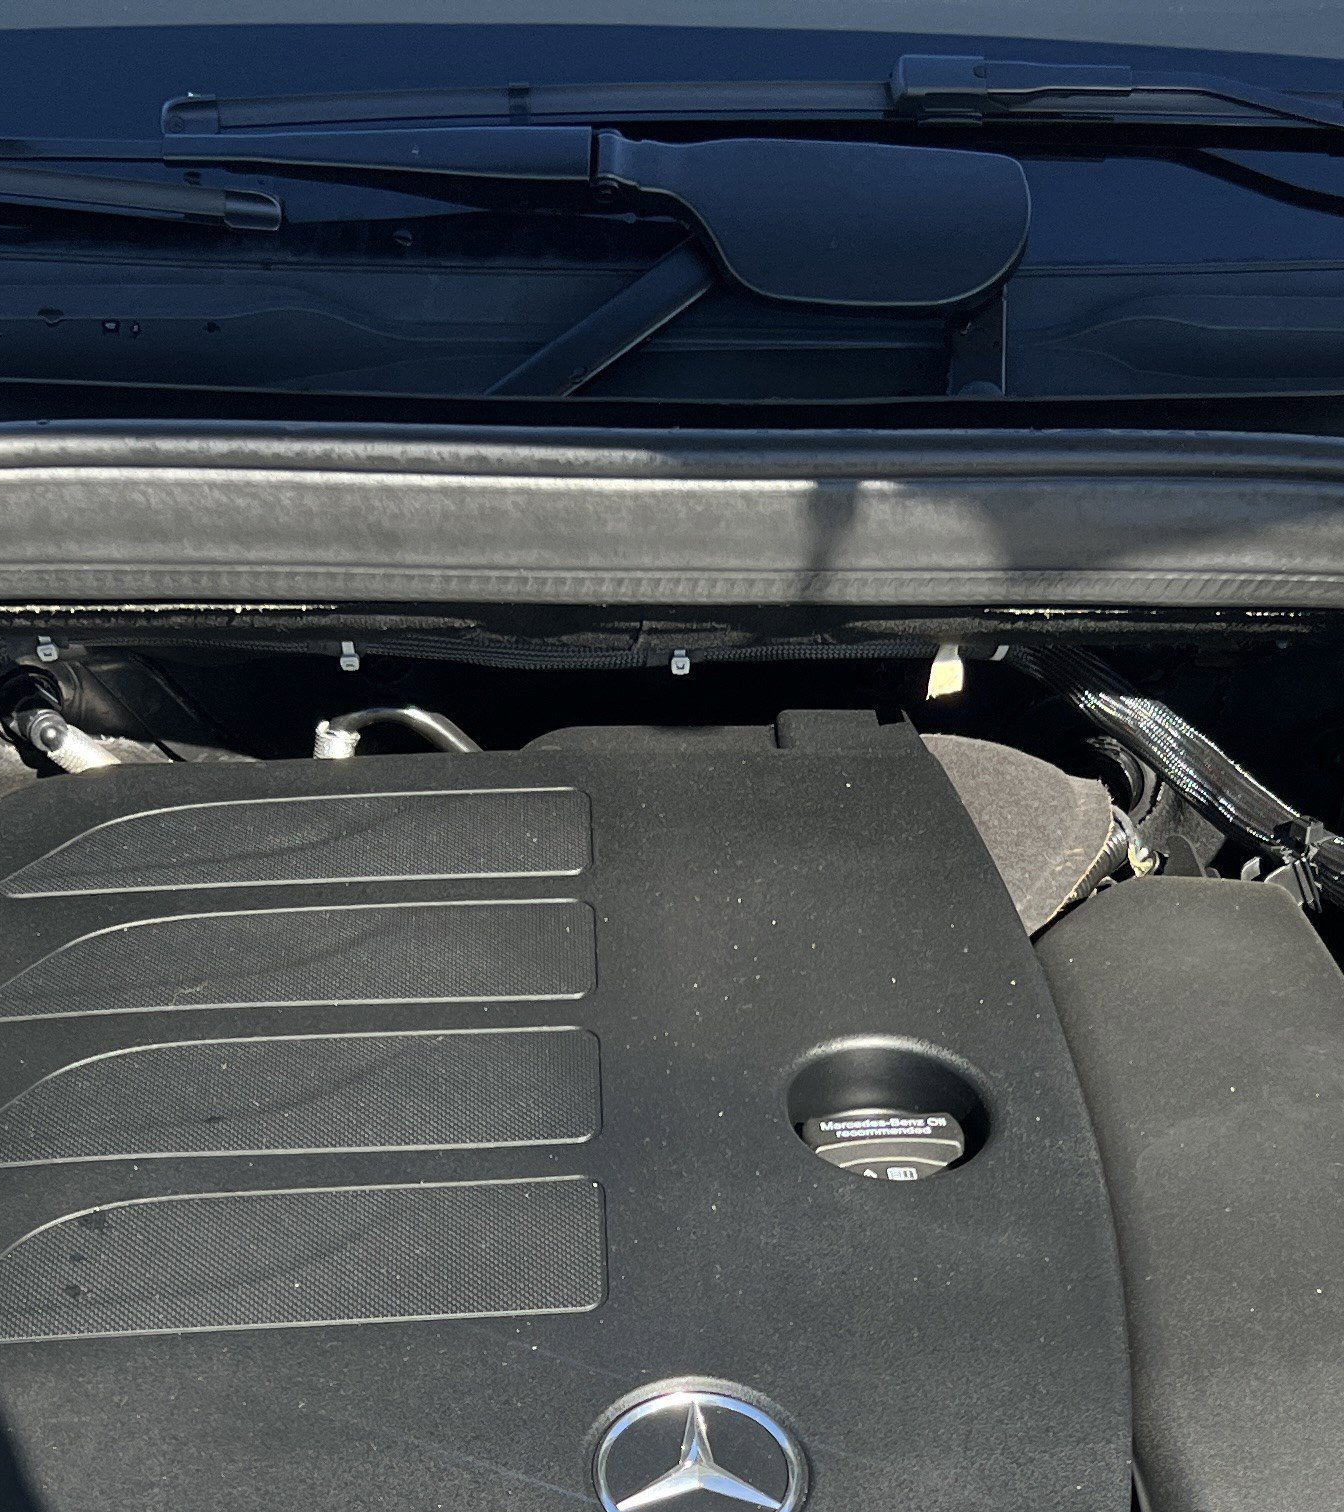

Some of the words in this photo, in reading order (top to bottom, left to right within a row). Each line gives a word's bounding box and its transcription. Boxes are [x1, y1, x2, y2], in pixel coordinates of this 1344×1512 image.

[819, 1117, 926, 1132] Mercedes-Benz
[926, 1117, 947, 1128] Oil
[835, 1126, 932, 1139] recommended
